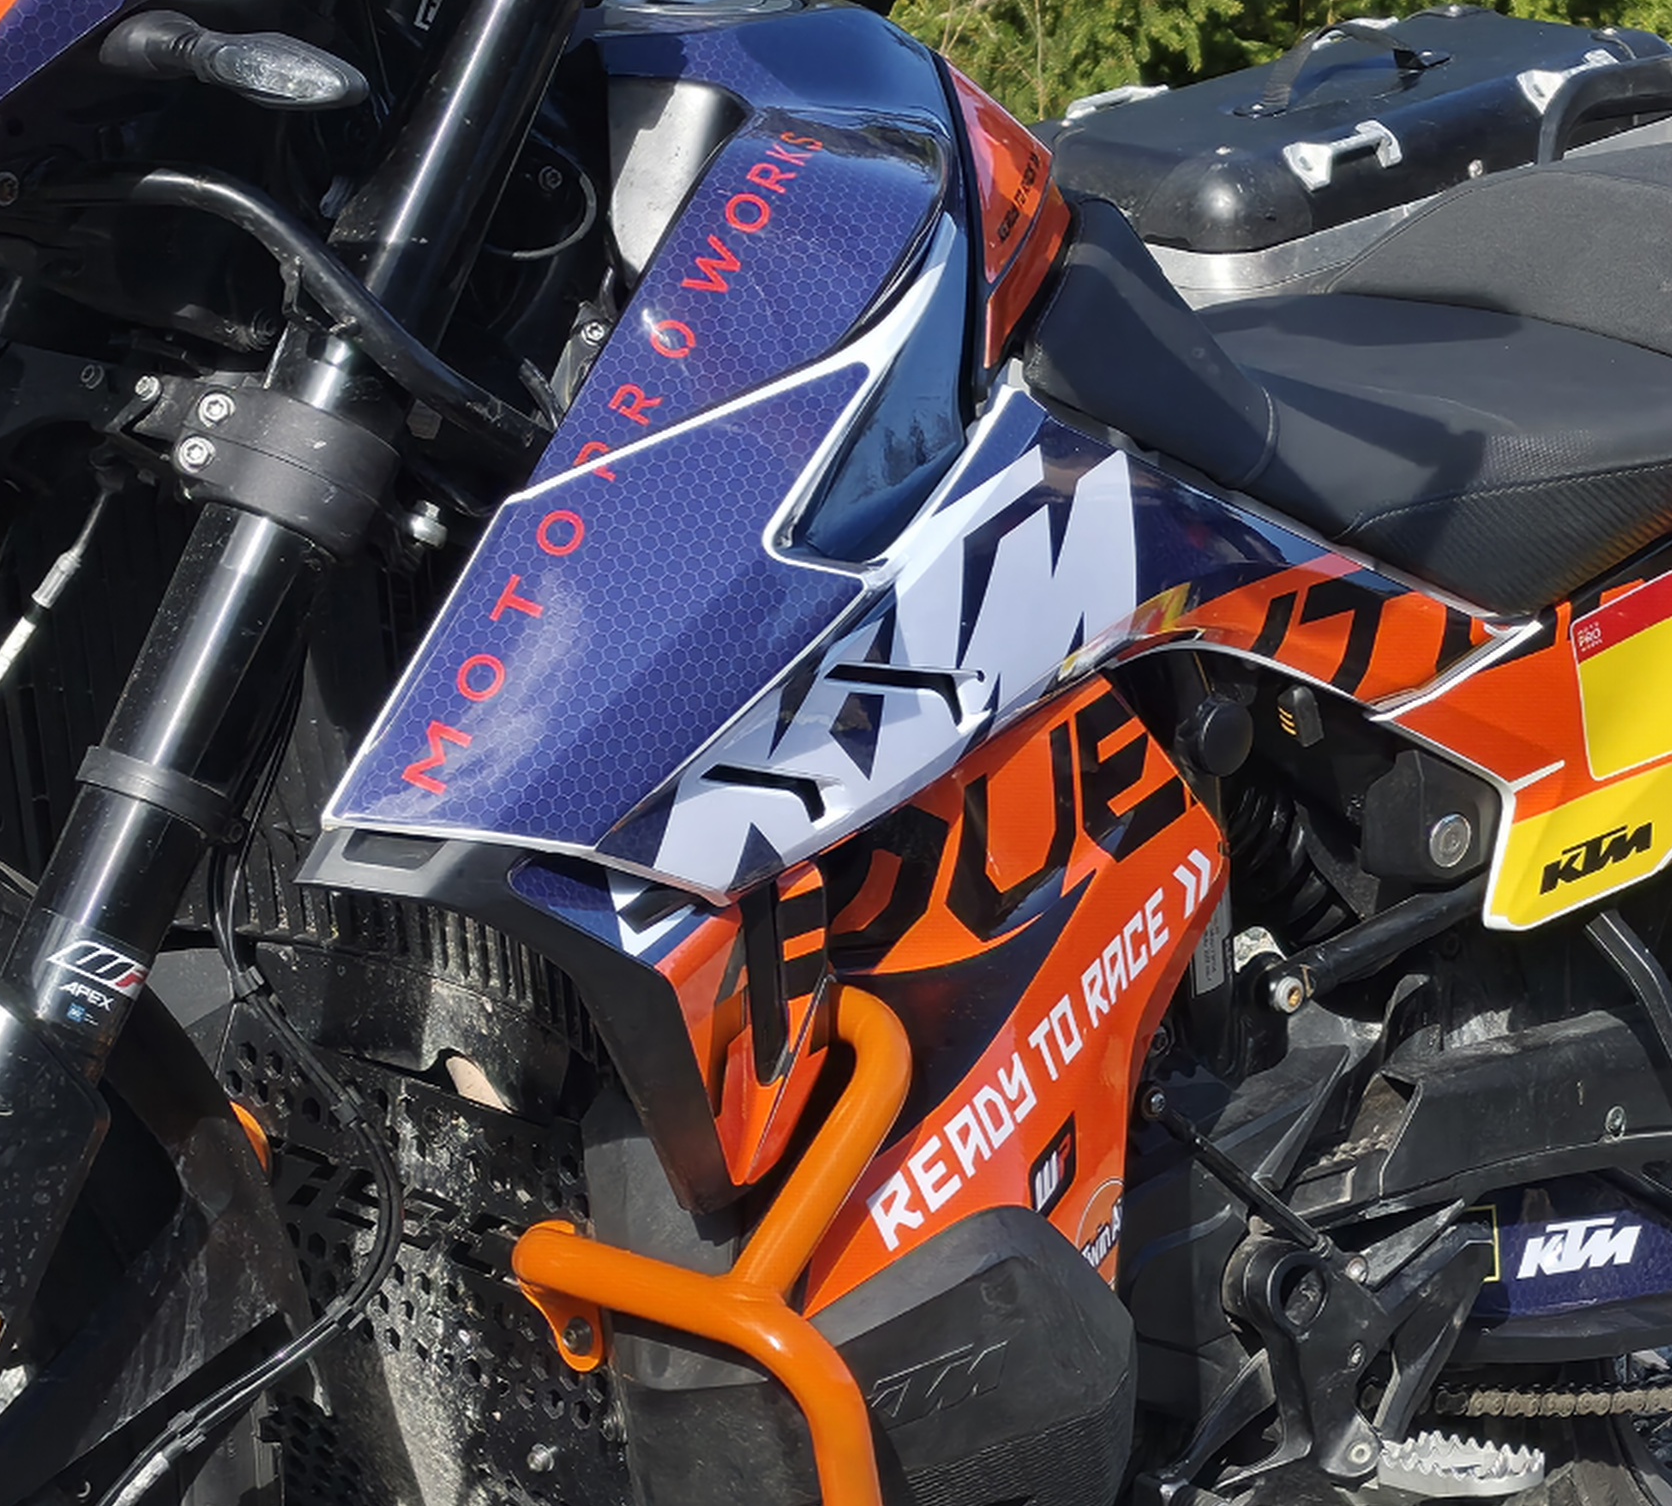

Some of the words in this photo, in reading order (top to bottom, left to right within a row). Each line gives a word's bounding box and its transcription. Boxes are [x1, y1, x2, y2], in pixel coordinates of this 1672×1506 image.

[1579, 628, 1602, 647] PRO
[1539, 822, 1653, 895] KTM
[59, 981, 115, 1012] APEX
[866, 1052, 1038, 1252] READY
[1028, 994, 1084, 1081] TO
[1081, 887, 1171, 1029] RACE
[1516, 1216, 1644, 1281] KTM
